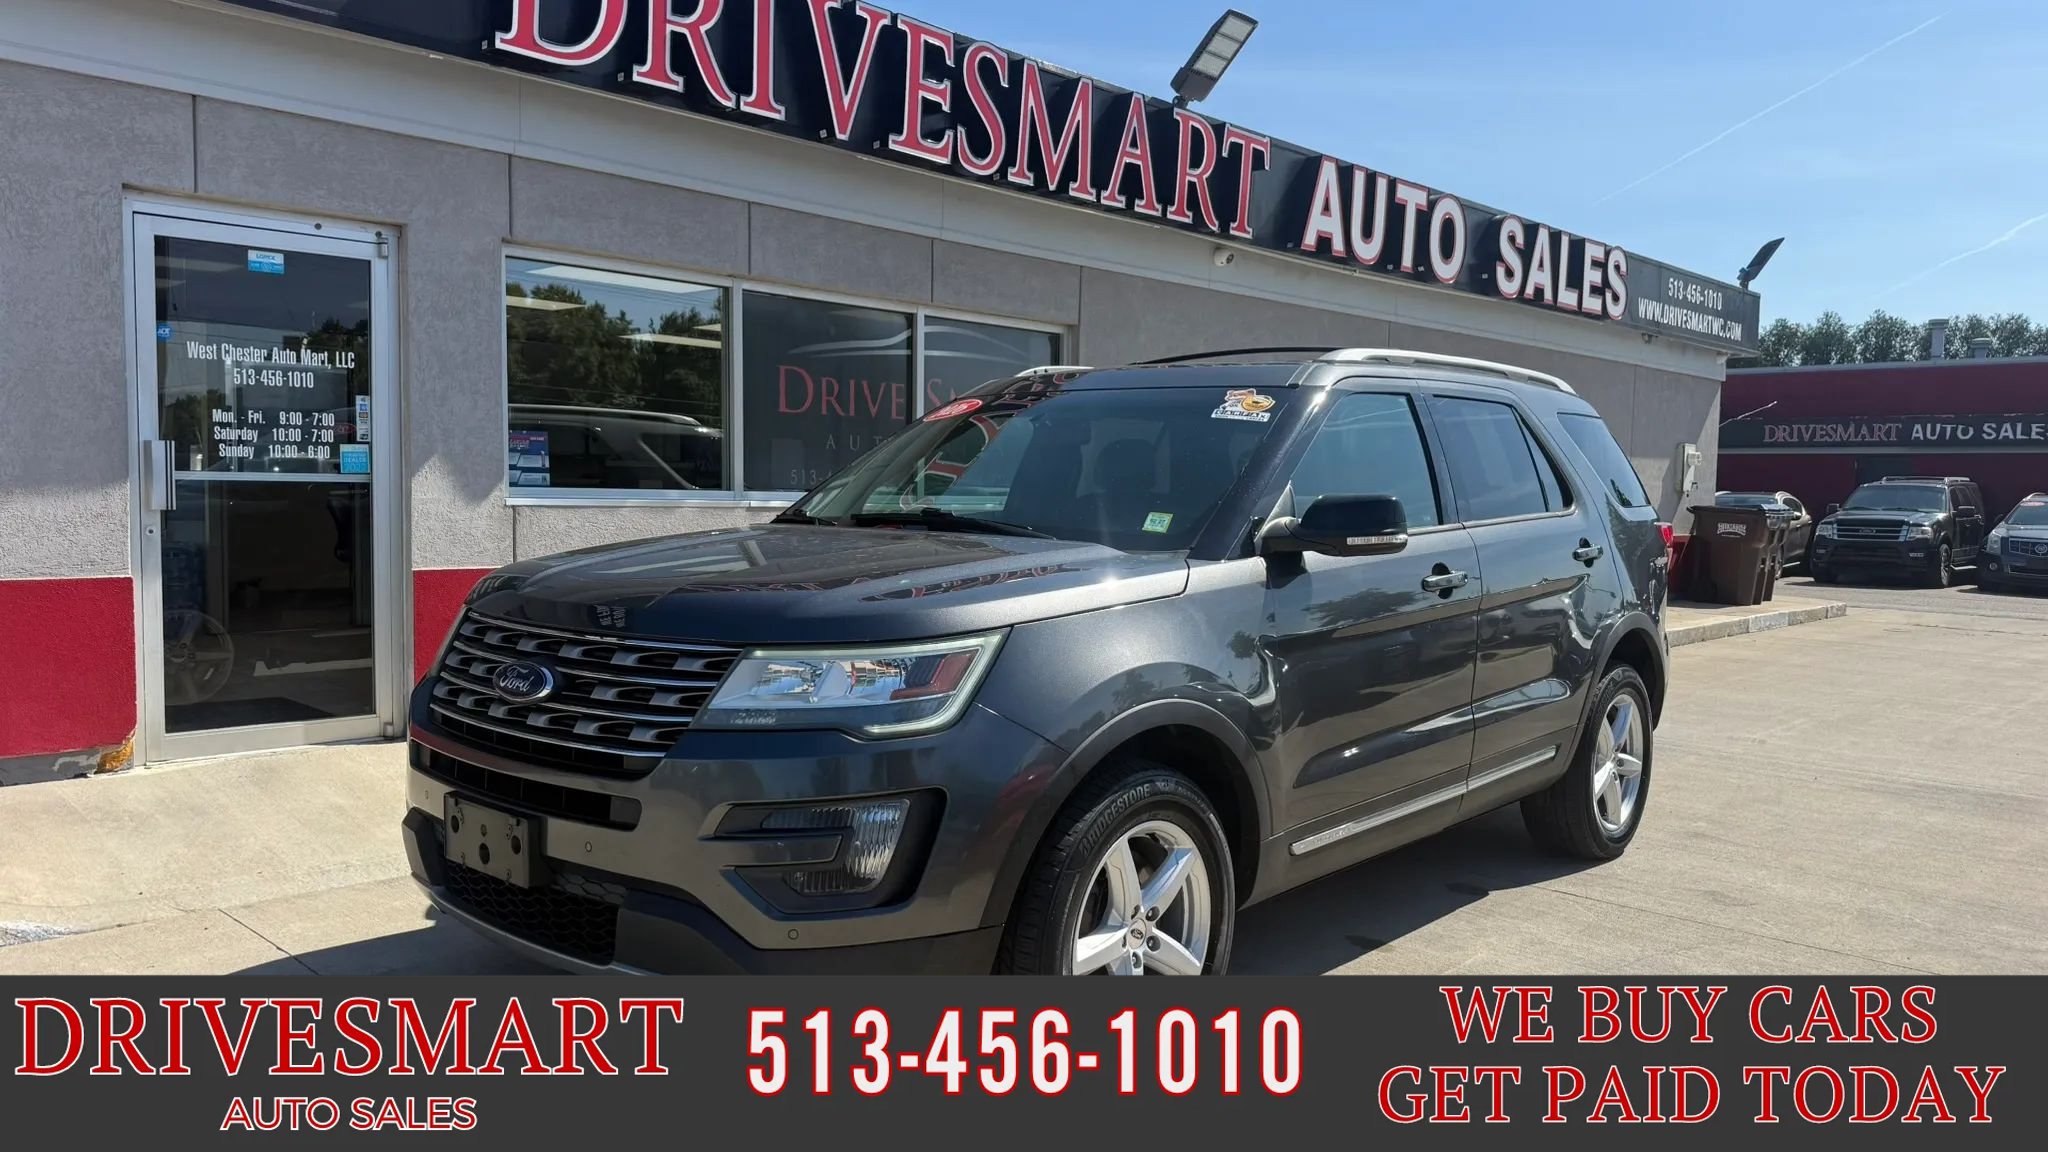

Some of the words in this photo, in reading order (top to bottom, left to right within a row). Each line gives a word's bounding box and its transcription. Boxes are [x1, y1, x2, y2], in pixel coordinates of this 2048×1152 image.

[1300, 155, 1467, 284] AUTO
[1496, 214, 1629, 321] SALES
[1668, 277, 1722, 311] 513-456-1010
[1638, 297, 1742, 341] WWW.DRIVESMARTWC.COM
[186, 341, 217, 360] West
[222, 343, 267, 363] Chester
[272, 347, 297, 365] Auto
[300, 348, 332, 370] Mart,
[336, 351, 355, 369] LLC
[233, 368, 315, 388] 513-456-1010
[776, 365, 905, 420] DRIVE
[212, 409, 237, 424] Mon.
[248, 410, 266, 424] Fri.
[279, 411, 302, 425] 9:00
[312, 413, 335, 426] 7:00
[214, 426, 258, 443] Saturday
[272, 428, 302, 442] 10:00
[311, 429, 334, 443] 7:00
[826, 434, 886, 450] AUT
[1763, 423, 1902, 443] DRIVESMART
[1911, 423, 1974, 441] AUTO
[219, 443, 255, 459] Sunday
[268, 445, 302, 459] 10:00
[307, 445, 330, 459] 6:00
[500, 666, 534, 692] Ford
